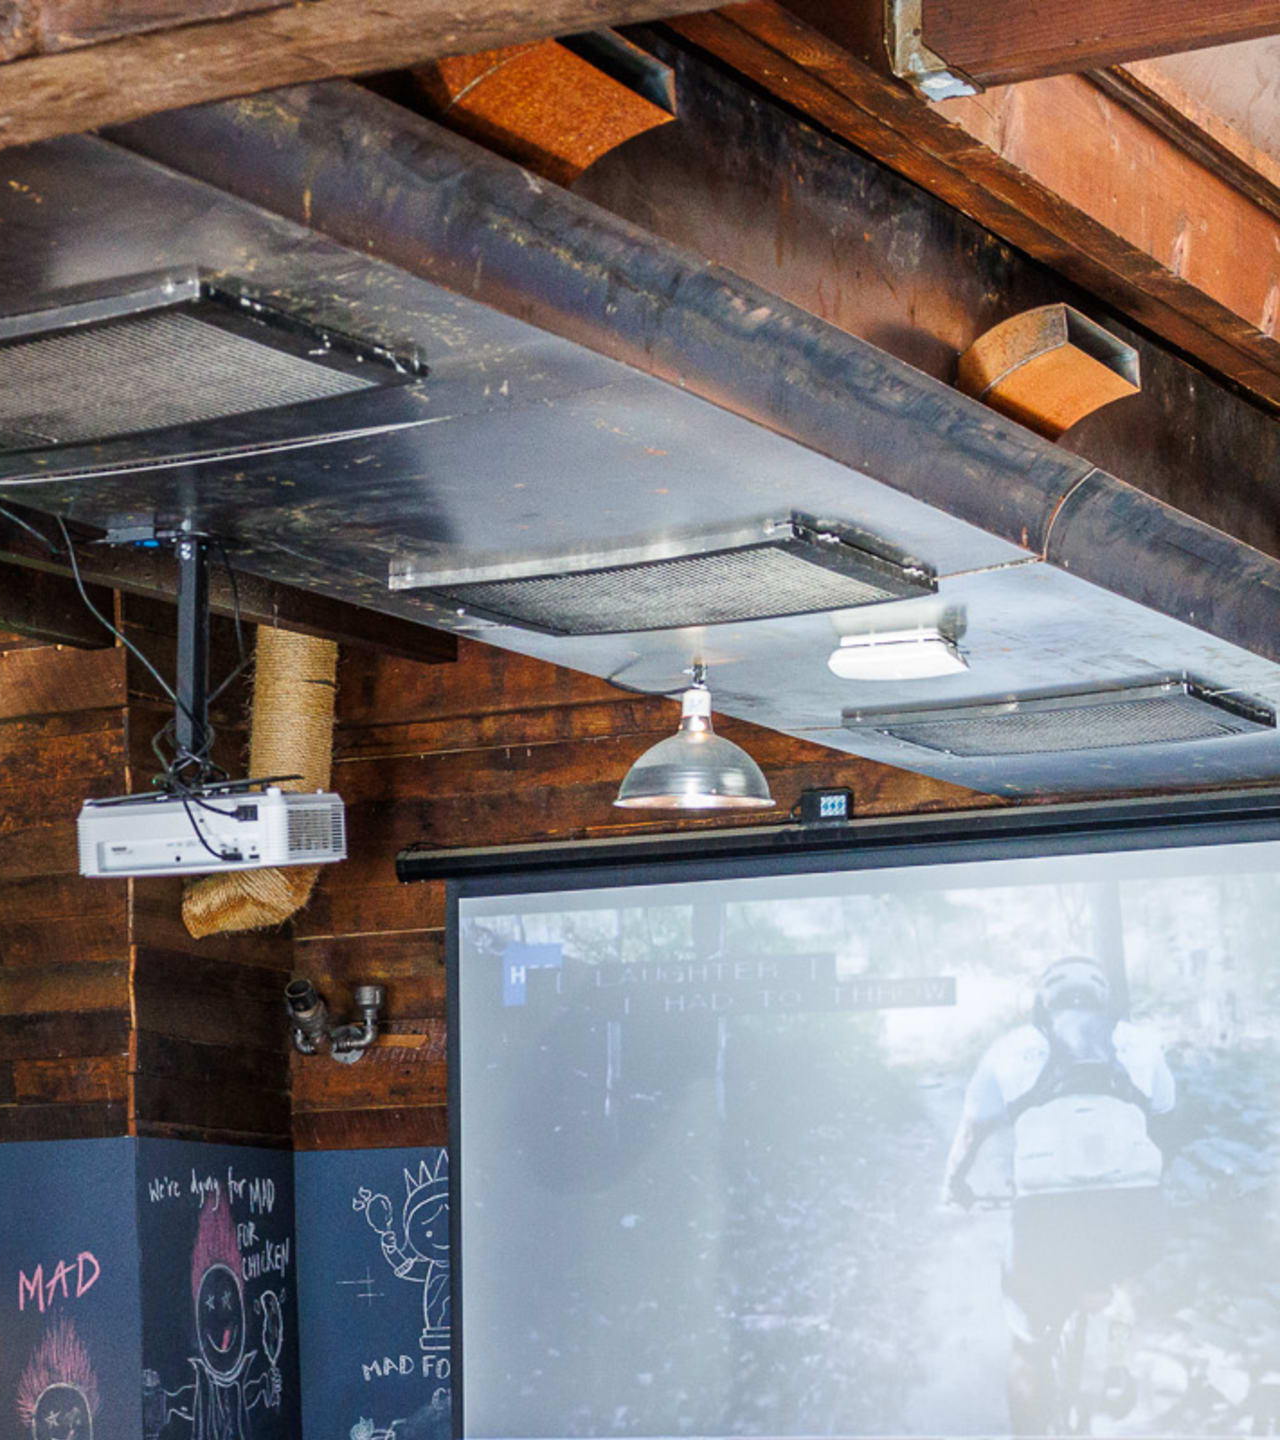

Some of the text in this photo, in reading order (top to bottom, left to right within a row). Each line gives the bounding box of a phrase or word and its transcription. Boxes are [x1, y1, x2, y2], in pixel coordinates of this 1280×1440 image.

[596, 961, 779, 988] LAUGHTER
[664, 992, 734, 1013] HAD
[760, 991, 802, 1008] TO
[237, 1221, 260, 1250] FOR
[19, 1251, 101, 1312] MAD
[362, 1355, 414, 1382] MAD
